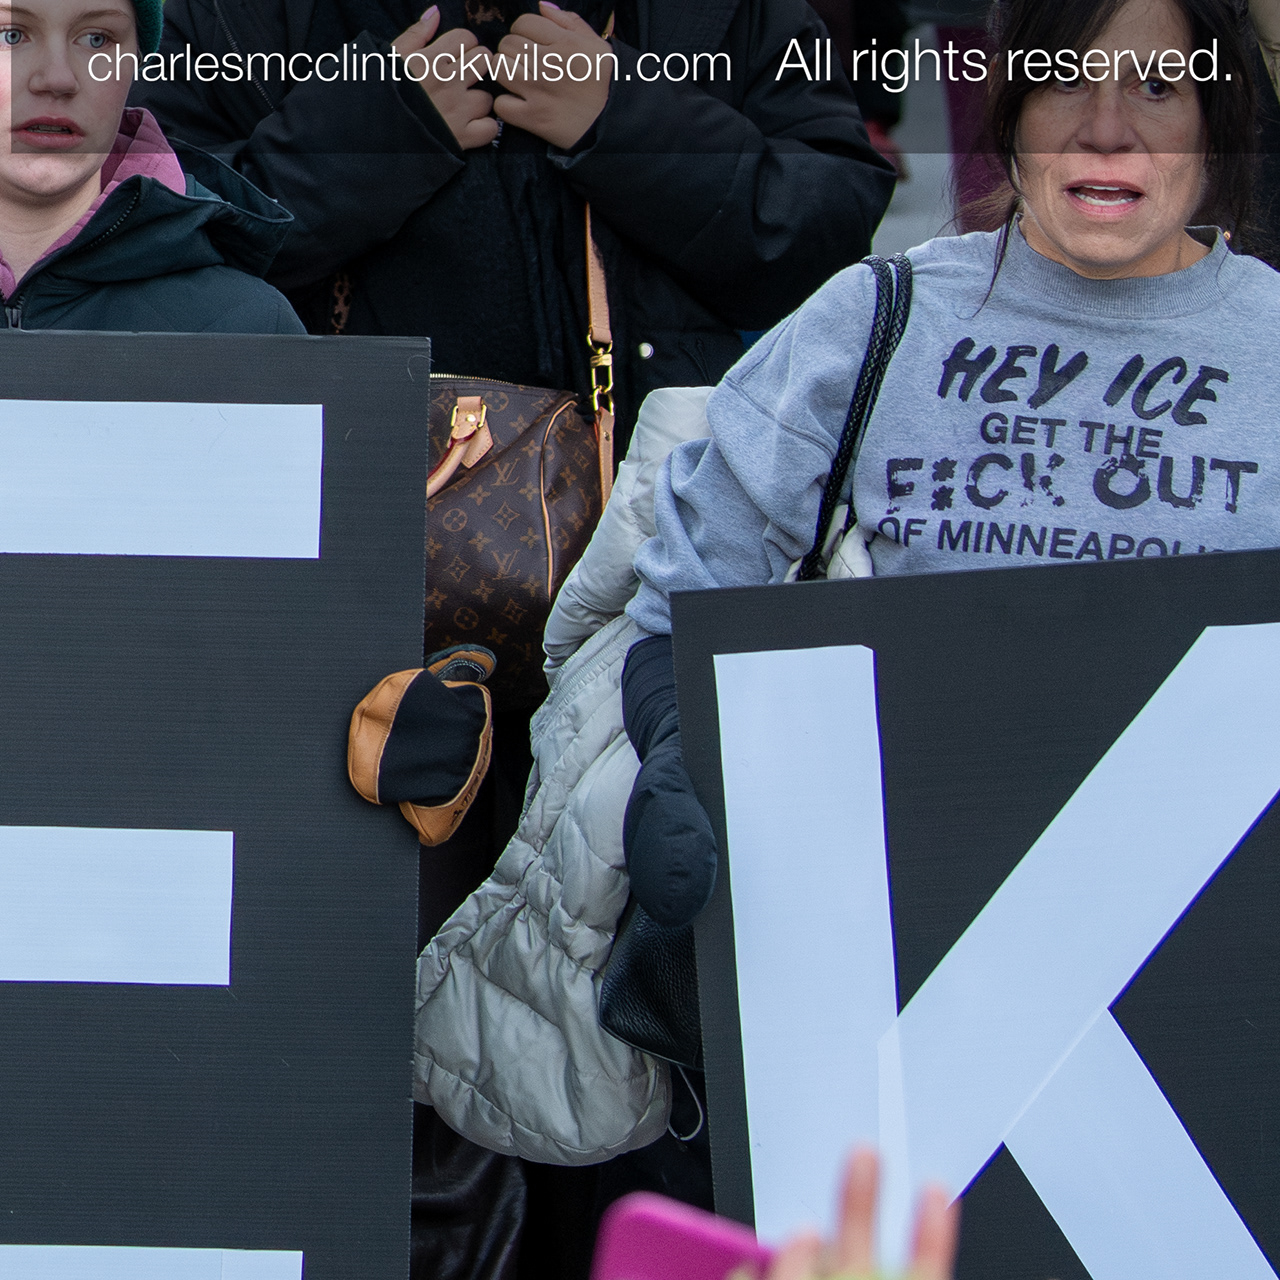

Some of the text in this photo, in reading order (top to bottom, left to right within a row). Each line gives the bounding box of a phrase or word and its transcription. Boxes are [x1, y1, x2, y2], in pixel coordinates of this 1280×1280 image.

[937, 336, 1230, 426] HEY ICE
[980, 412, 1164, 459] GET THE
[1092, 453, 1259, 514] OUT
[877, 516, 1226, 561] OF MINNEAPO
